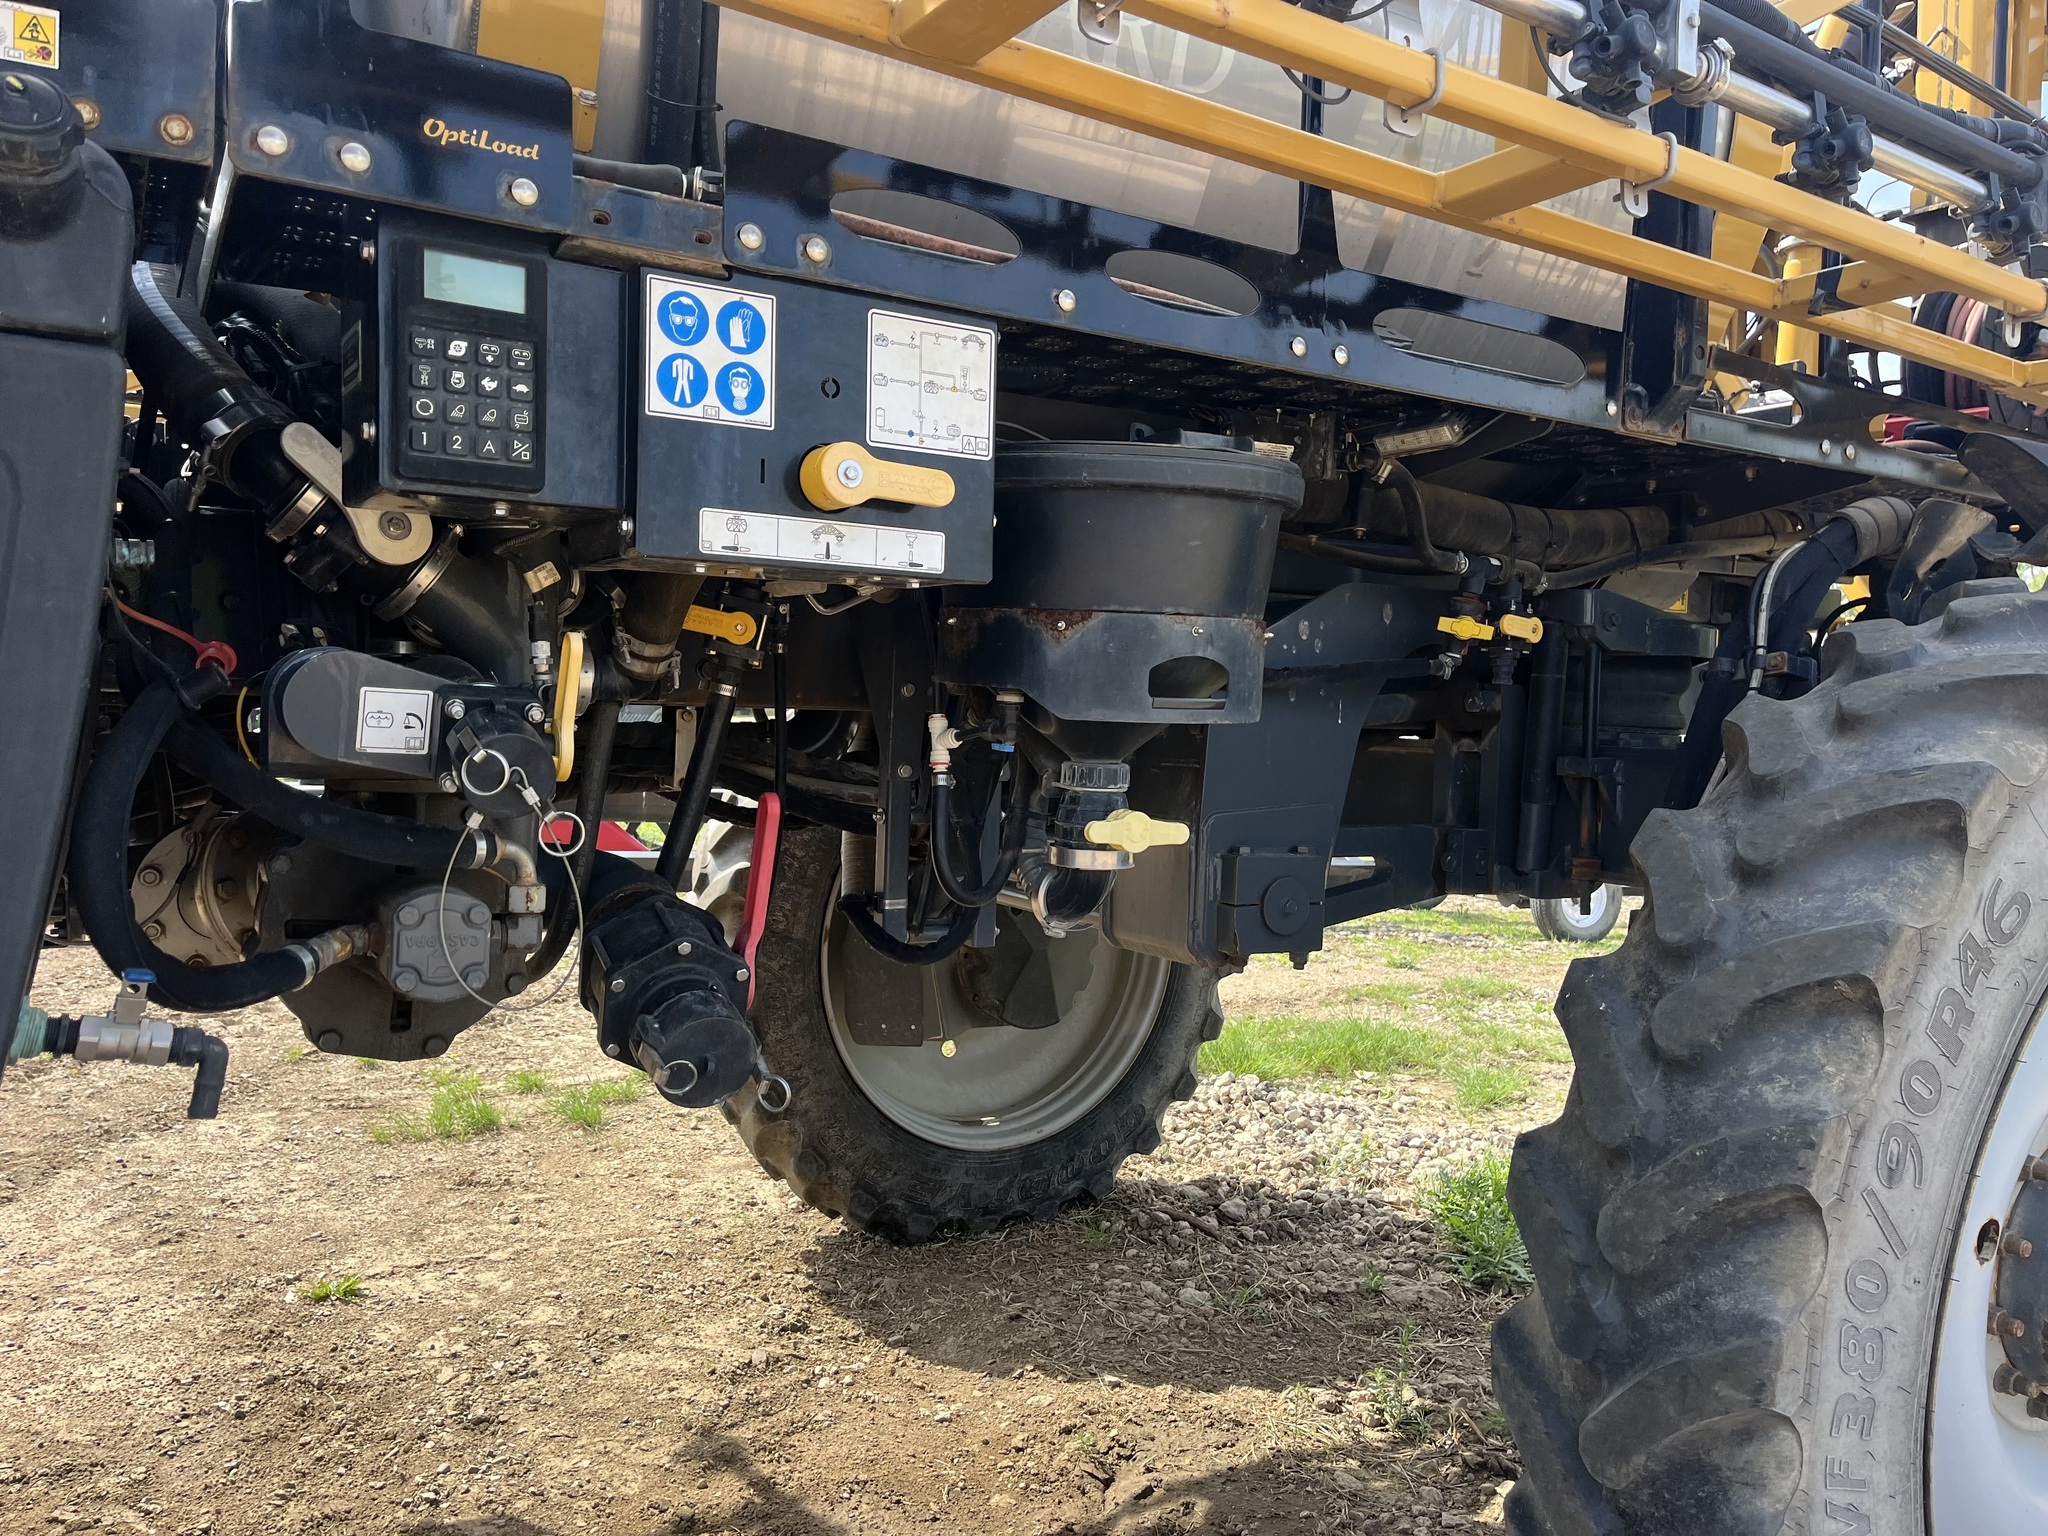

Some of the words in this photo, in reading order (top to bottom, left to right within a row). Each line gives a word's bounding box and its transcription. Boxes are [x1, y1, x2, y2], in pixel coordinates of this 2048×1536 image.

[423, 118, 539, 160] OptiLoad
[421, 431, 427, 446] 1
[452, 435, 462, 450] 2
[482, 440, 495, 454] A
[404, 933, 480, 949] CASPPA
